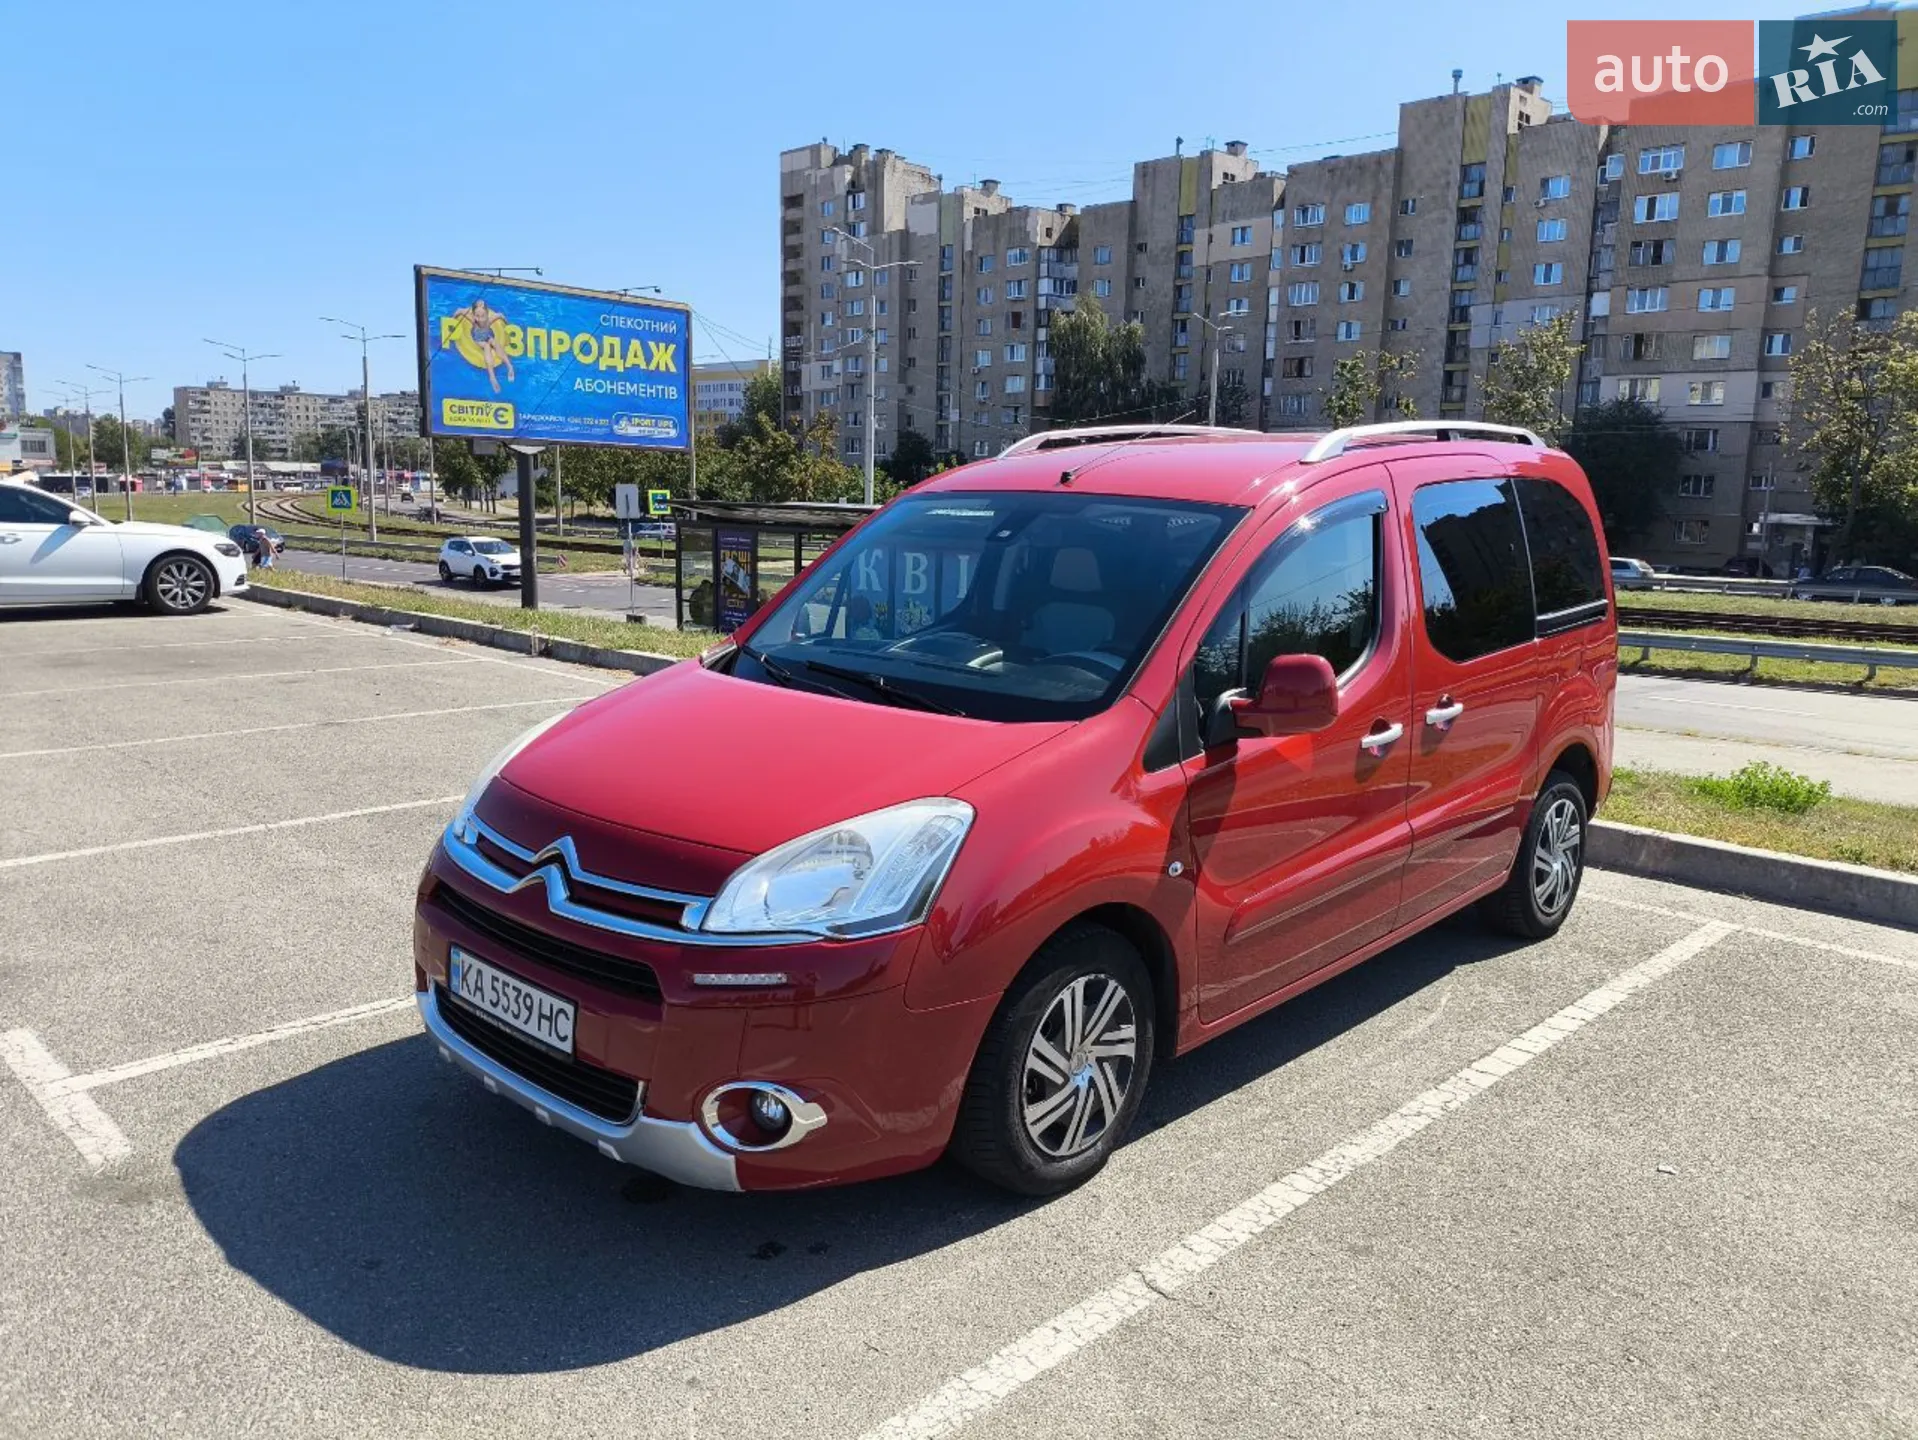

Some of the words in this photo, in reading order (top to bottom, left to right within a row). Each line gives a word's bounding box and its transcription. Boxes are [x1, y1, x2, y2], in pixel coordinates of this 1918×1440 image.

[599, 313, 678, 335] СПЕКОТНИЙ
[573, 377, 679, 400] АБОНЕМЕНТІВ
[460, 959, 485, 1003] KA
[489, 975, 534, 1025] 5539
[537, 997, 570, 1042] HC
